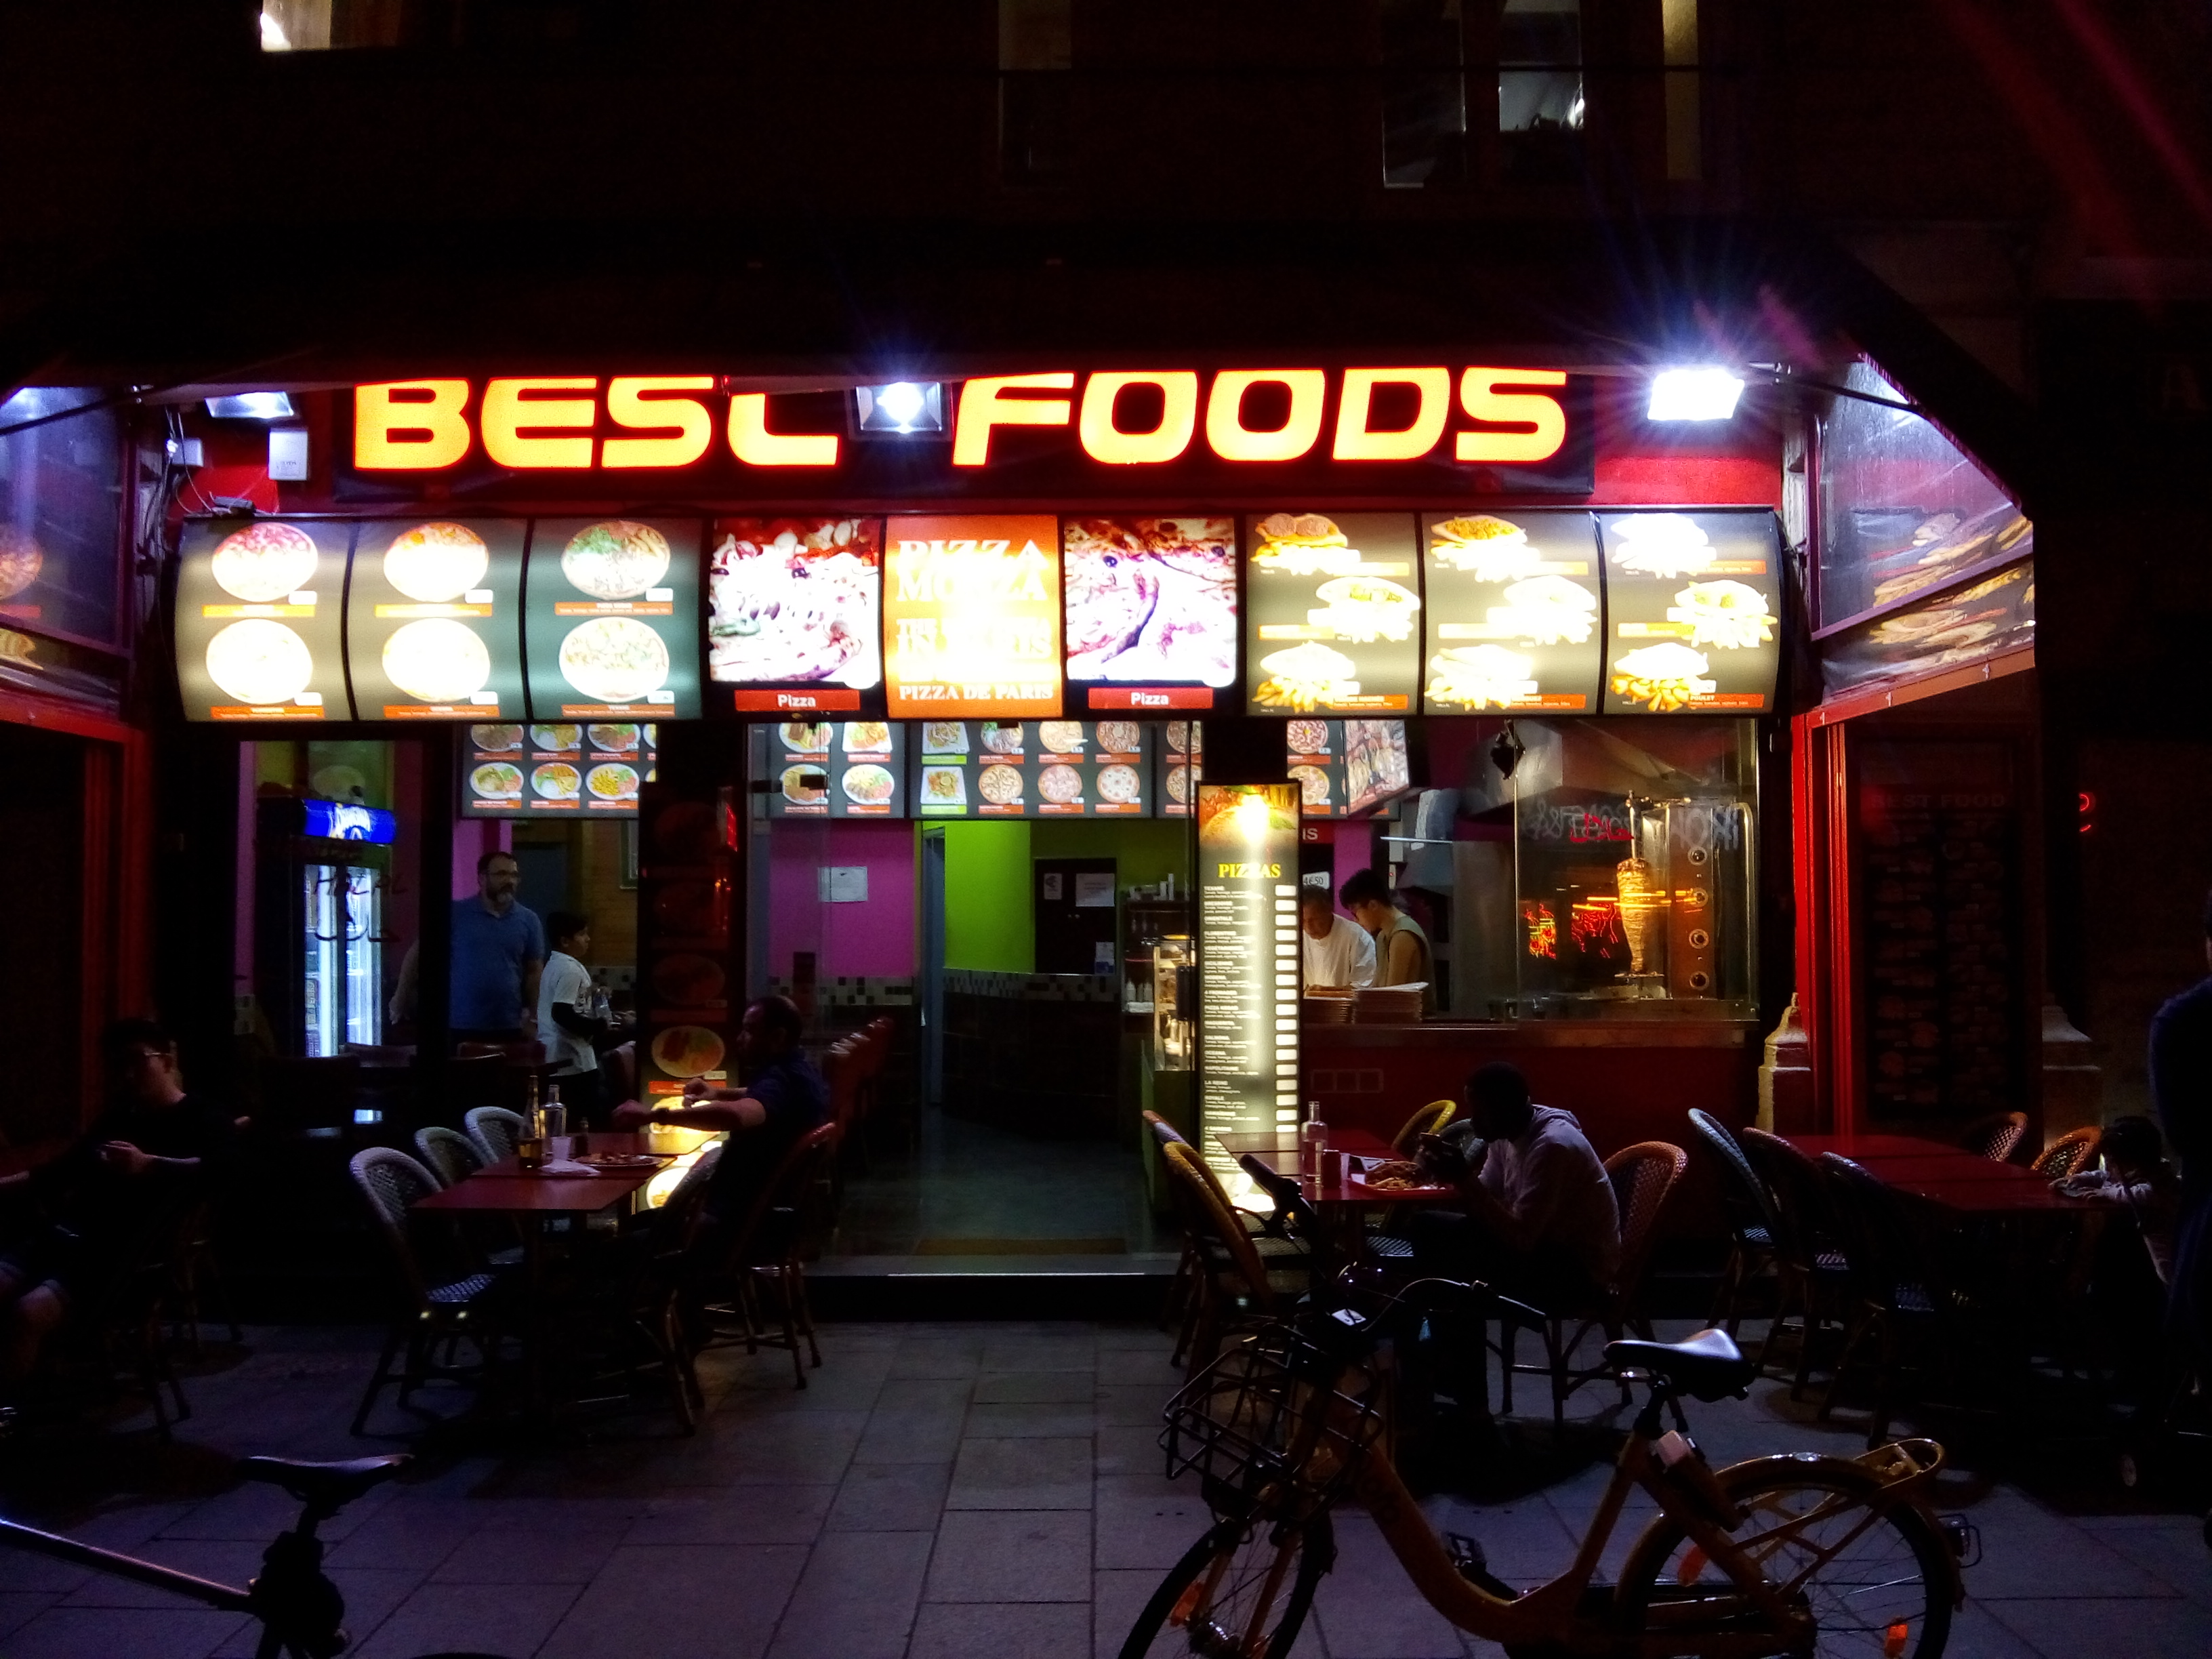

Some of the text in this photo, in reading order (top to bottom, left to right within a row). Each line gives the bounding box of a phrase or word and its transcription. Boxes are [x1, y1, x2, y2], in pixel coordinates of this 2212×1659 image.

[951, 367, 1568, 466] FOODS
[898, 539, 1050, 569] PIZZA
[895, 568, 1048, 601] MOZA
[777, 692, 817, 709] Pizza
[899, 684, 1054, 700] PIZZA DE PARIS
[1130, 690, 1170, 707] Pizza
[1302, 827, 1319, 840] IS
[1217, 863, 1282, 879] PIZZAS
